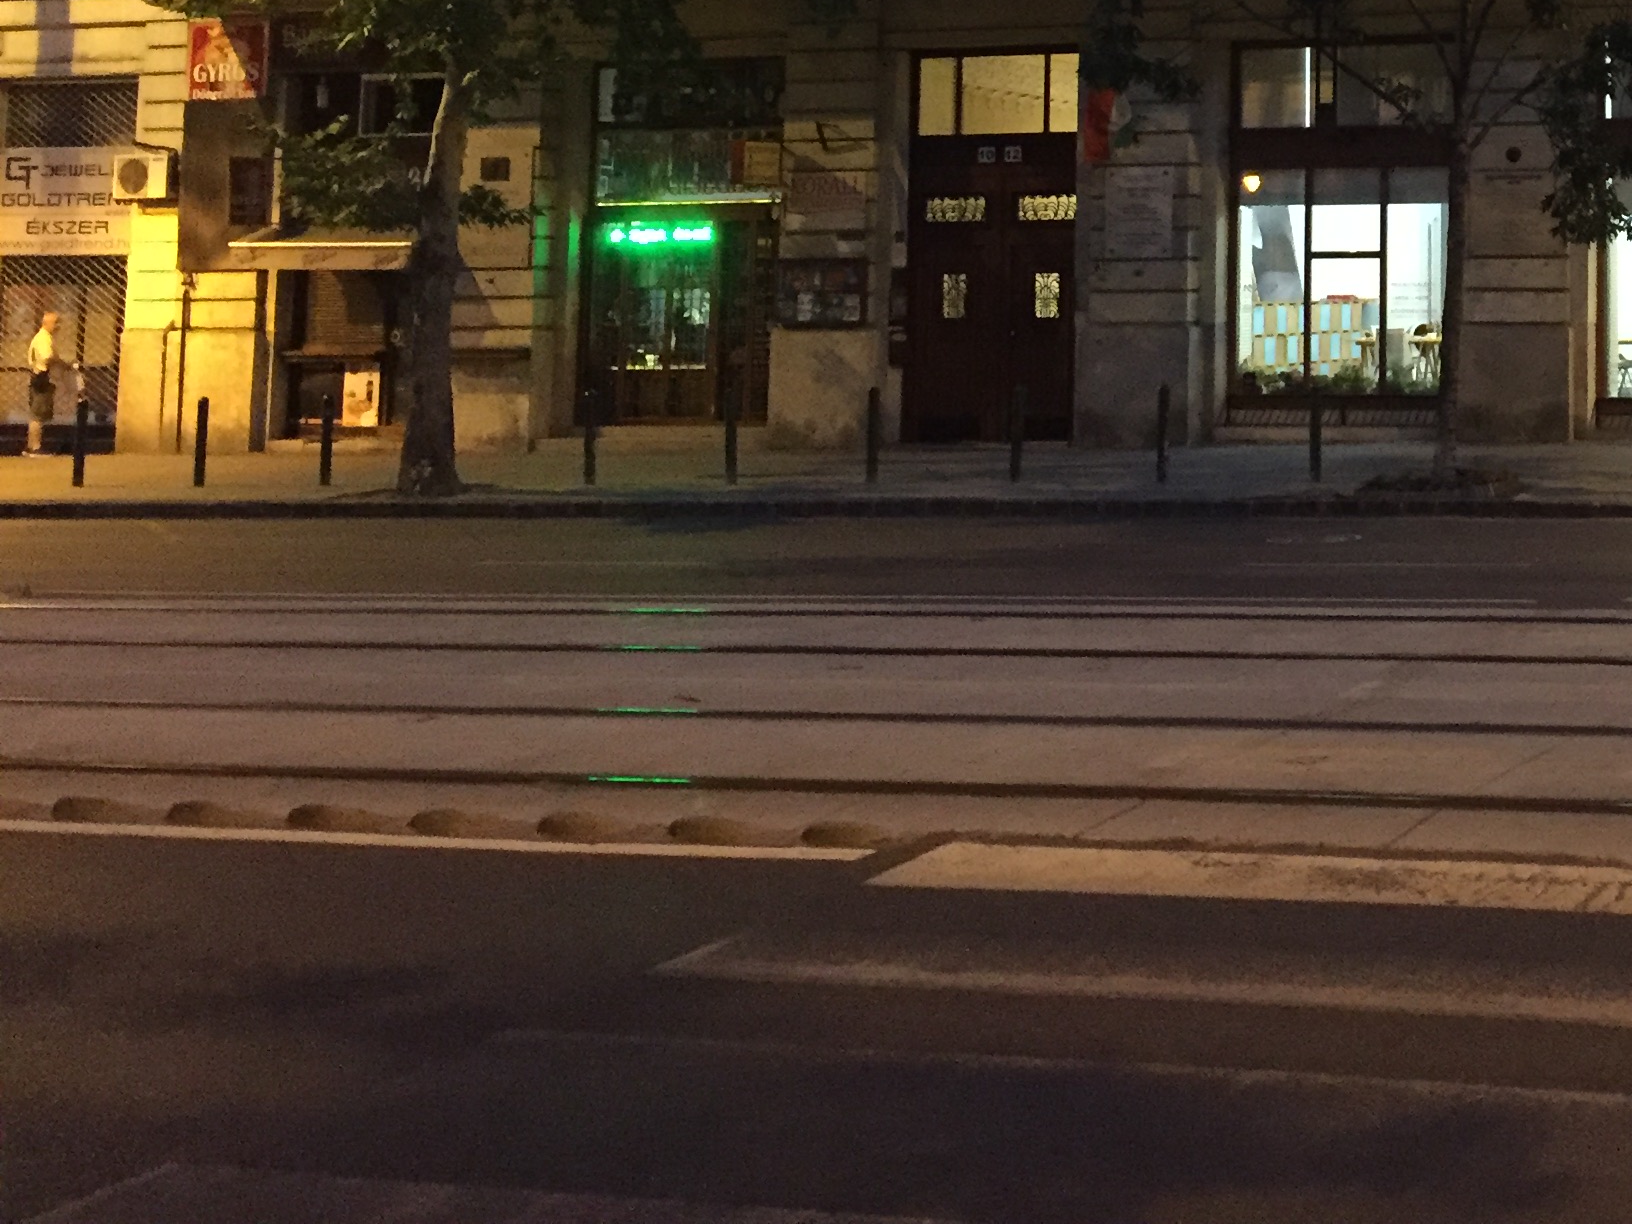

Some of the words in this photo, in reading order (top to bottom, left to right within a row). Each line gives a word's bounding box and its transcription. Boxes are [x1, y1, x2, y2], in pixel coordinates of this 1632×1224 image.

[193, 63, 259, 82] GYROS
[41, 164, 111, 176] JEWEL
[26, 218, 109, 234] ÉKSZER
